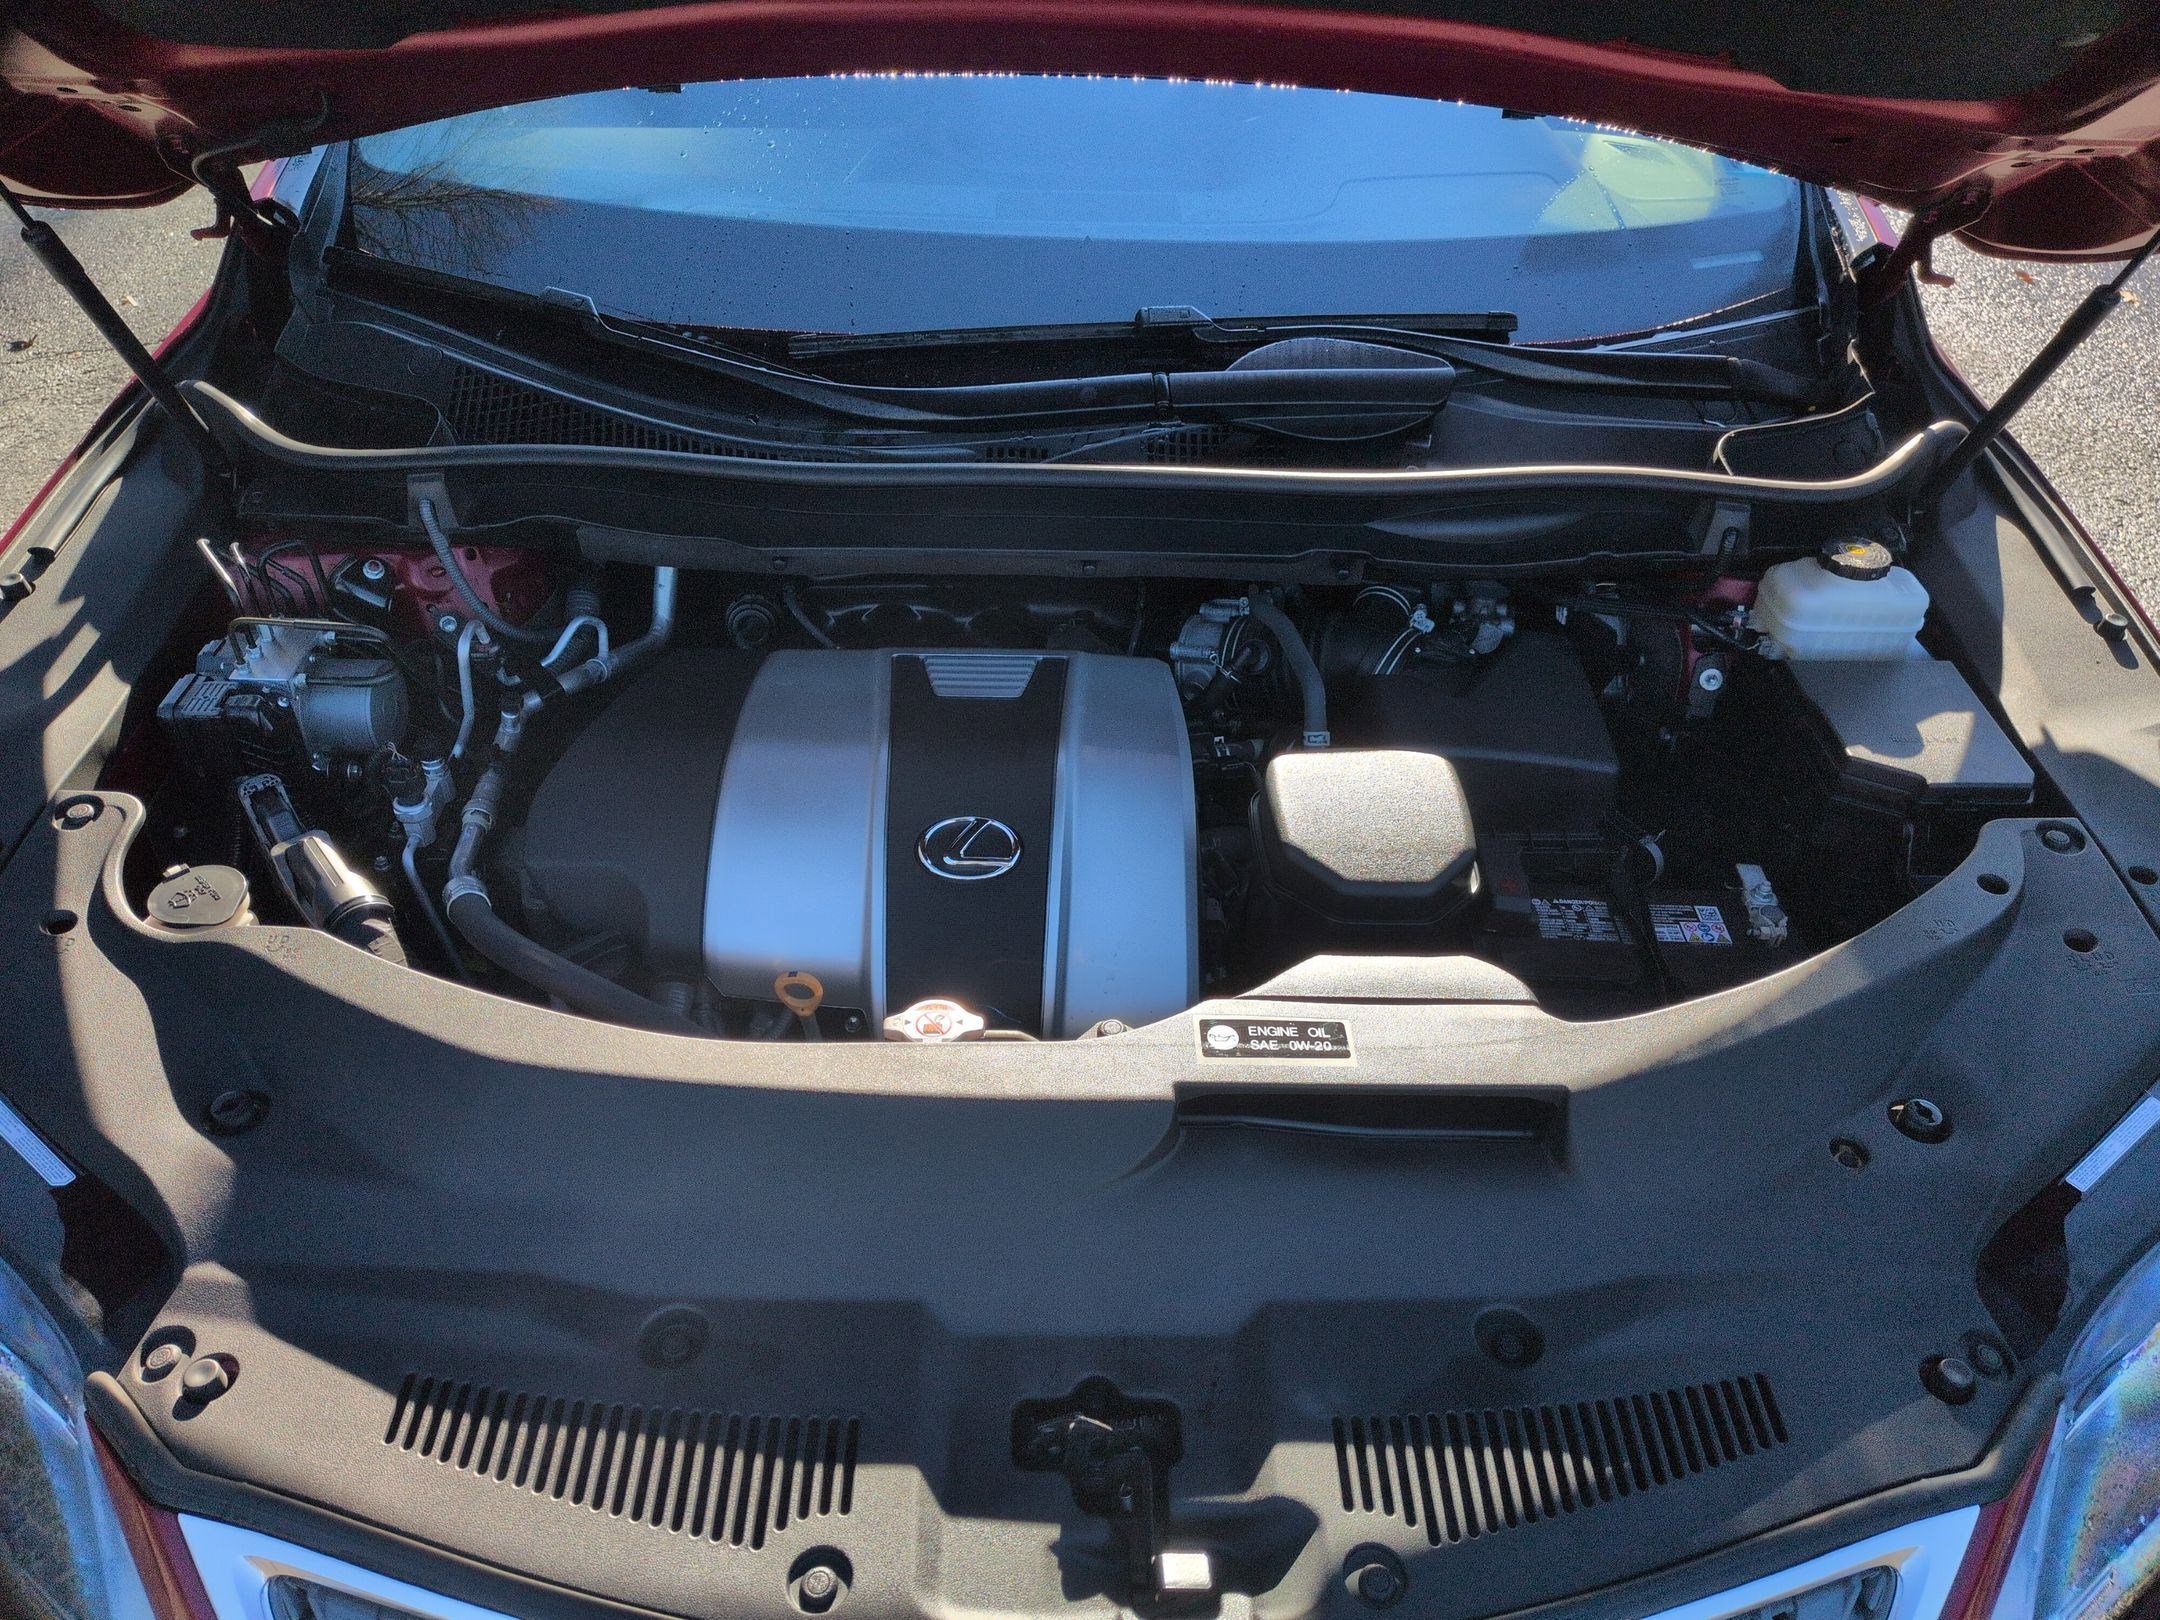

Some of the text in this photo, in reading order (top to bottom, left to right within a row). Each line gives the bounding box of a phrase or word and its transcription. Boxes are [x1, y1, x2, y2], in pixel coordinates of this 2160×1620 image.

[1247, 1025, 1331, 1038] ENGINE OIL
[1250, 1039, 1332, 1051] SAE 0W-20
